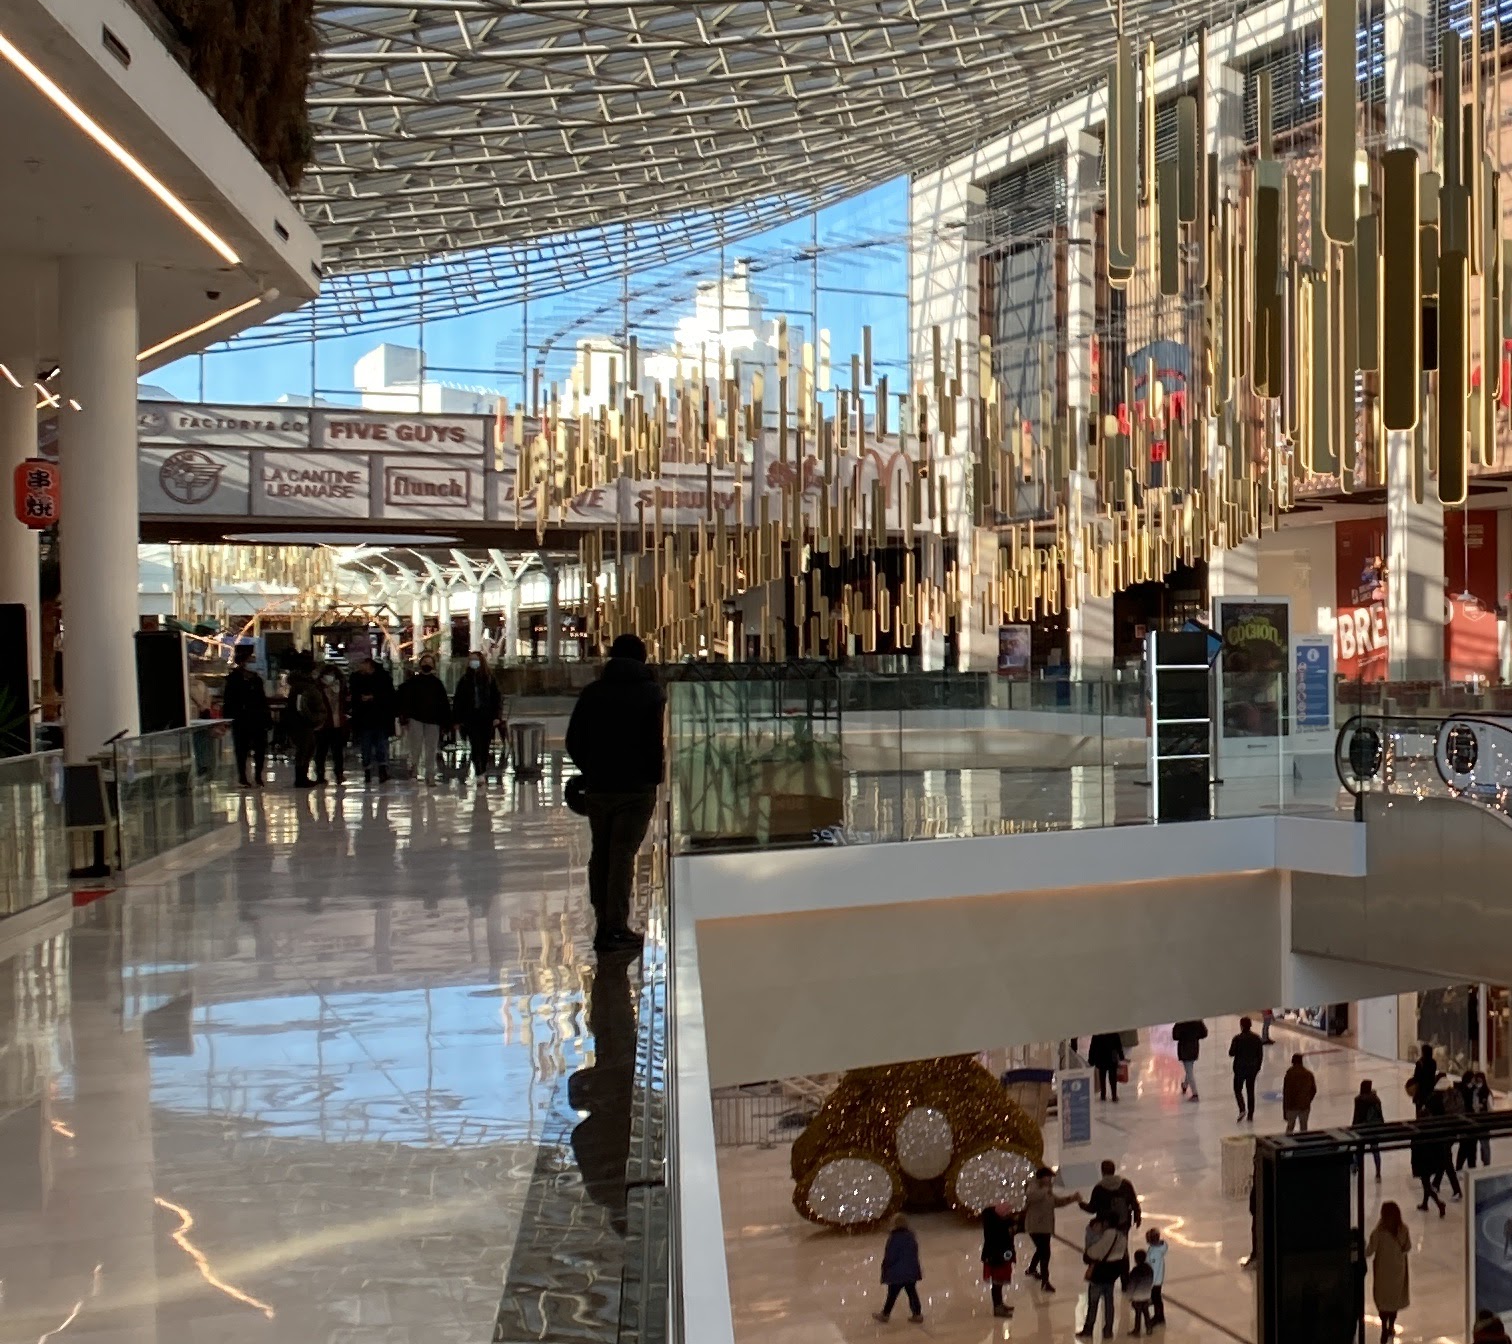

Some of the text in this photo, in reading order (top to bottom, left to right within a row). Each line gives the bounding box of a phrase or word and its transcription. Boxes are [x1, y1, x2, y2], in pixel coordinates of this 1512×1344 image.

[330, 421, 466, 443] FIVE GUYS
[260, 468, 361, 485] LA CANTINE
[267, 484, 355, 499] LIBANAISE
[393, 476, 463, 498] flunch
